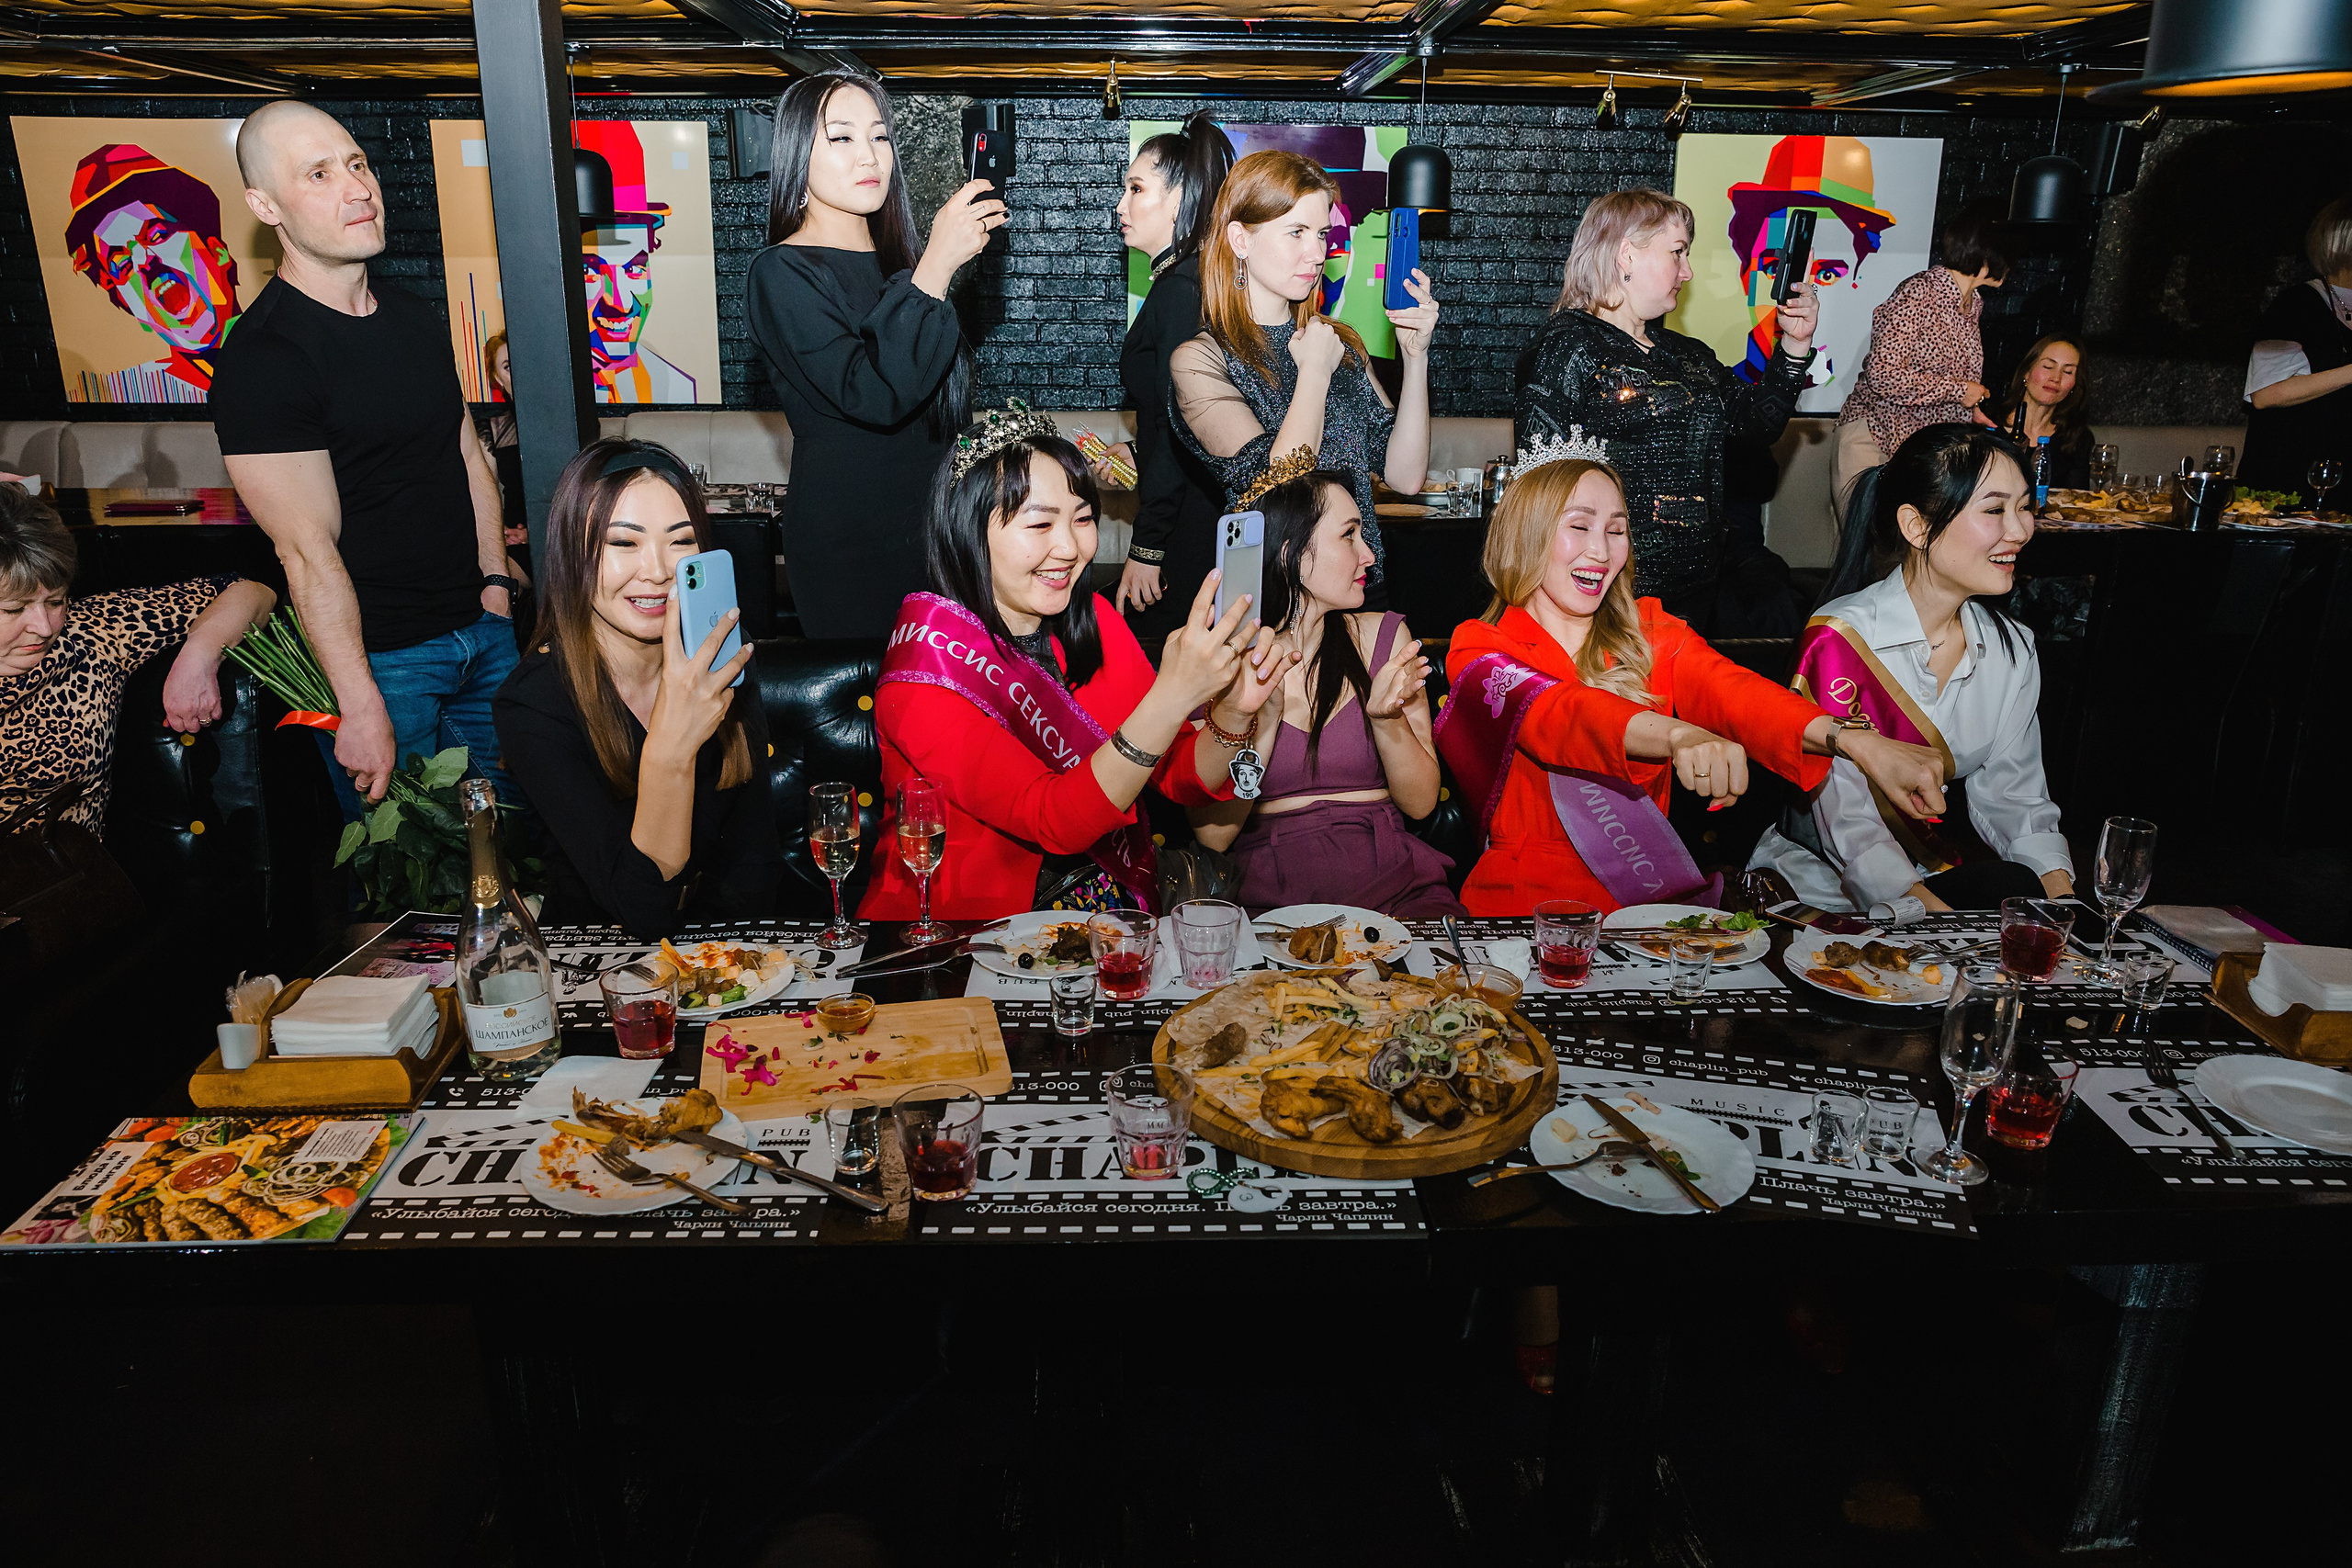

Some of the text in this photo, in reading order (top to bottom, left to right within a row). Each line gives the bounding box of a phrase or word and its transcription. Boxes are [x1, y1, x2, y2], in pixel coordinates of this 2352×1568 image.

[887, 622, 1004, 686] МИССИС
[1565, 998, 1653, 1009] chaplin_pub
[475, 1016, 549, 1040] ШАМПАНСКОЕ
[1552, 1044, 1624, 1060] 513-000
[1668, 1058, 1769, 1077] chaplin_pub
[481, 1087, 532, 1097] 513-0
[1690, 1098, 1785, 1117] MUSIC
[762, 1127, 811, 1137] PUB
[73, 1150, 122, 1191] Блюда на
[91, 1155, 132, 1191] мангале
[1759, 1176, 1837, 1195] Плачь
[371, 1206, 503, 1220] «Улыбайся
[966, 1201, 1098, 1214] «Улыбайся
[1105, 1202, 1206, 1215] сегодня.
[1298, 1200, 1397, 1212] завтра.»
[1821, 1196, 1943, 1220] Чарли Чаплин
[673, 1220, 791, 1230] Чарли Чаплин
[1275, 1213, 1395, 1223] Чарли Чаплин
